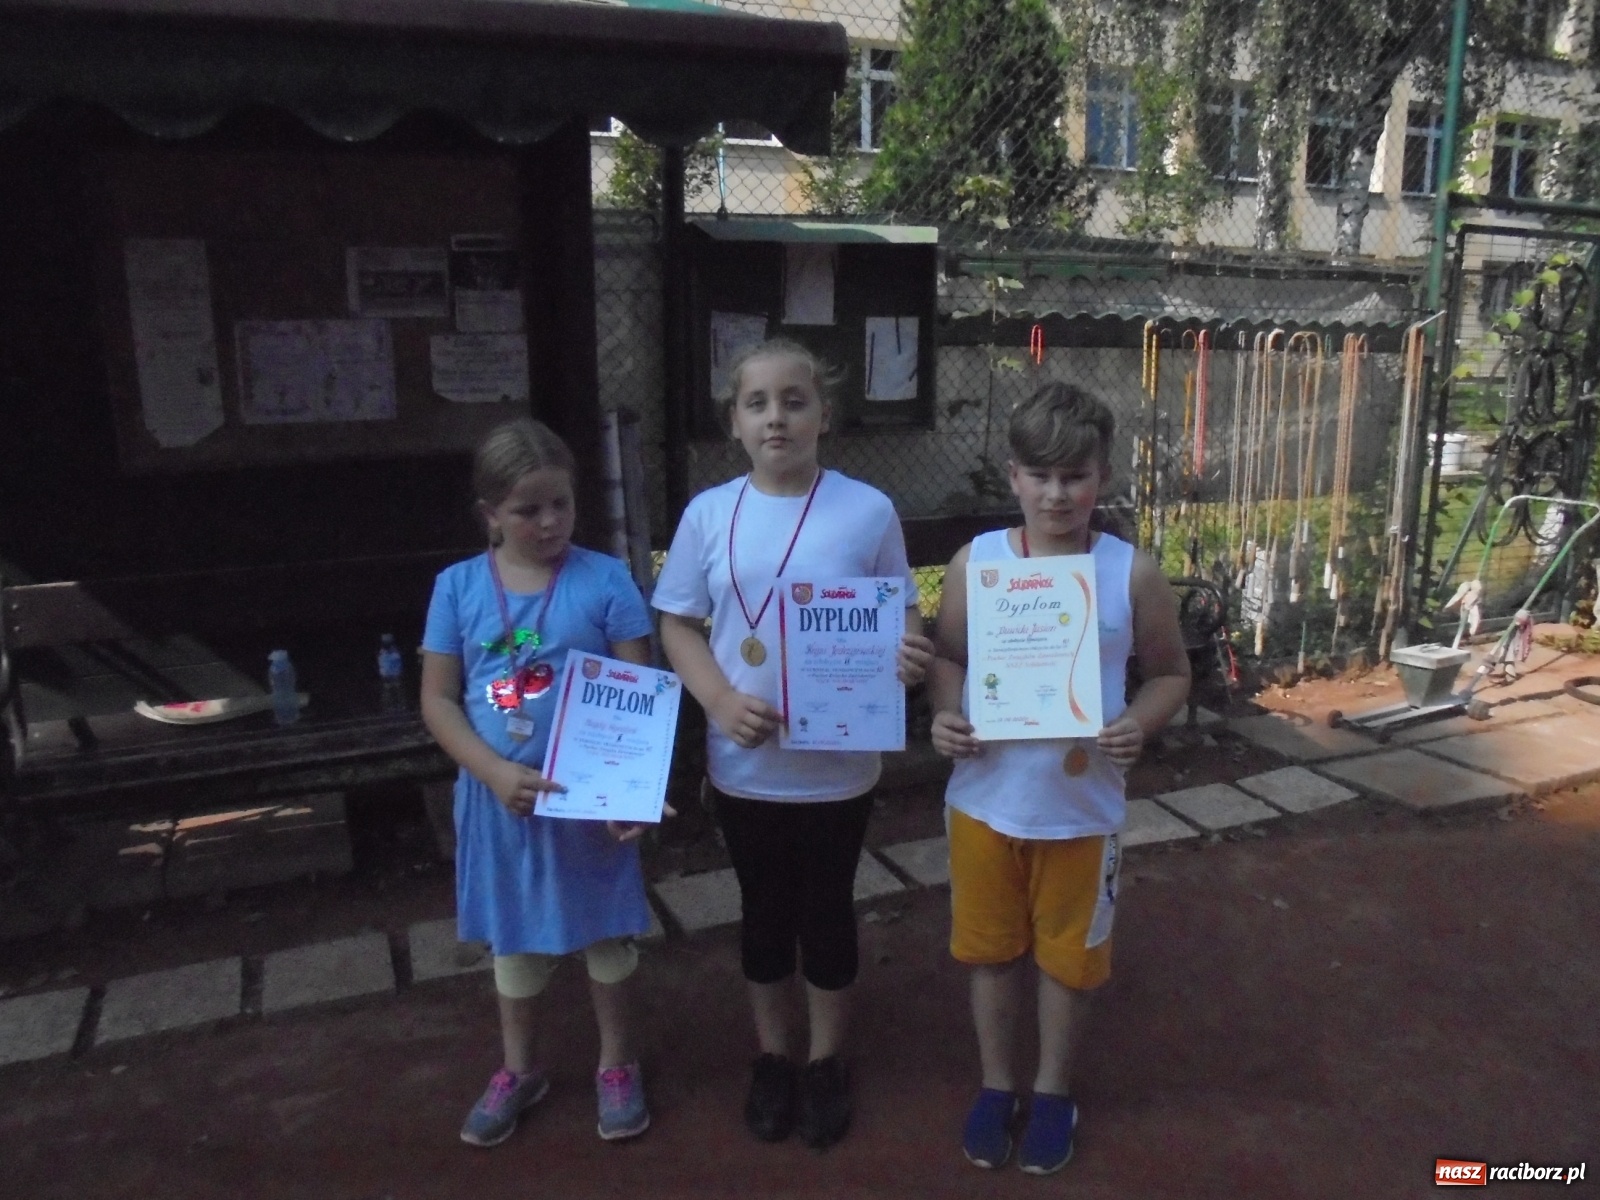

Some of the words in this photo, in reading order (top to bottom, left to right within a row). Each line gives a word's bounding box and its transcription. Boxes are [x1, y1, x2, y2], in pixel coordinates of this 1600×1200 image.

[995, 595, 1062, 617] Dyplom
[799, 607, 879, 633] DYPLOM
[581, 681, 655, 716] DYPLOM
